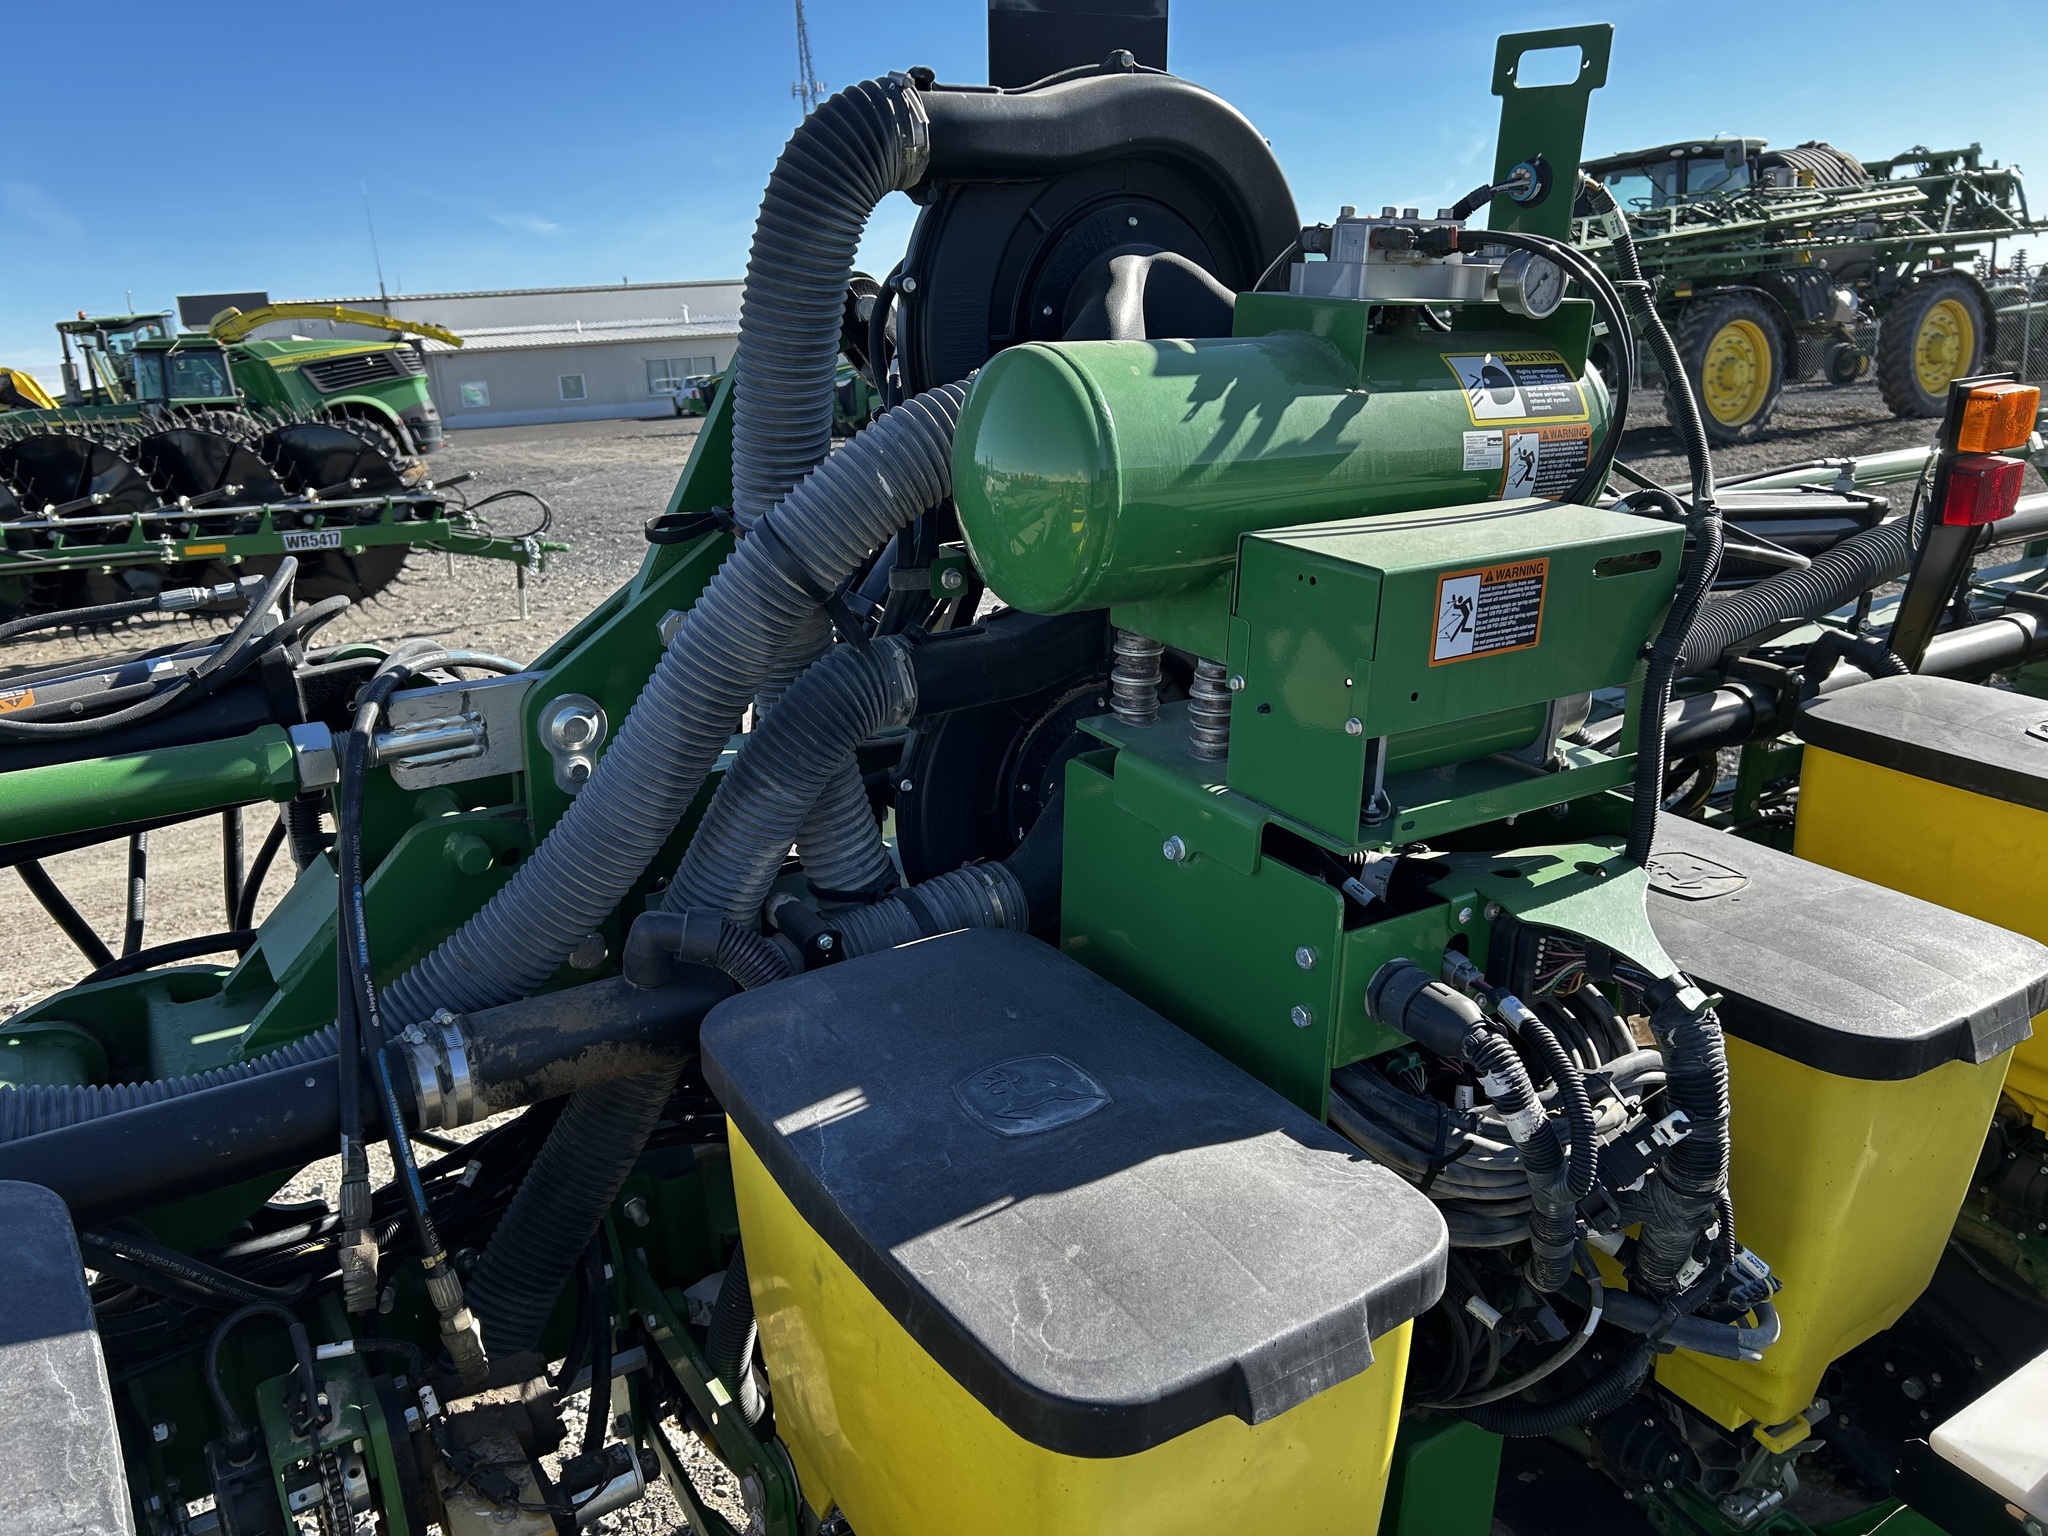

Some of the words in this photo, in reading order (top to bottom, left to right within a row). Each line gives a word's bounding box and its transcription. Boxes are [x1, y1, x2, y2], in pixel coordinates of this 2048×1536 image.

[1510, 352, 1560, 362] CAUTION
[1550, 427, 1588, 440] WARNING
[286, 533, 339, 548] WR5417
[1496, 563, 1543, 580] WARNING
[111, 1241, 128, 1251] 22.5
[129, 1246, 145, 1258] MPa
[145, 1252, 168, 1268] (3250
[168, 1261, 185, 1274] PSI)
